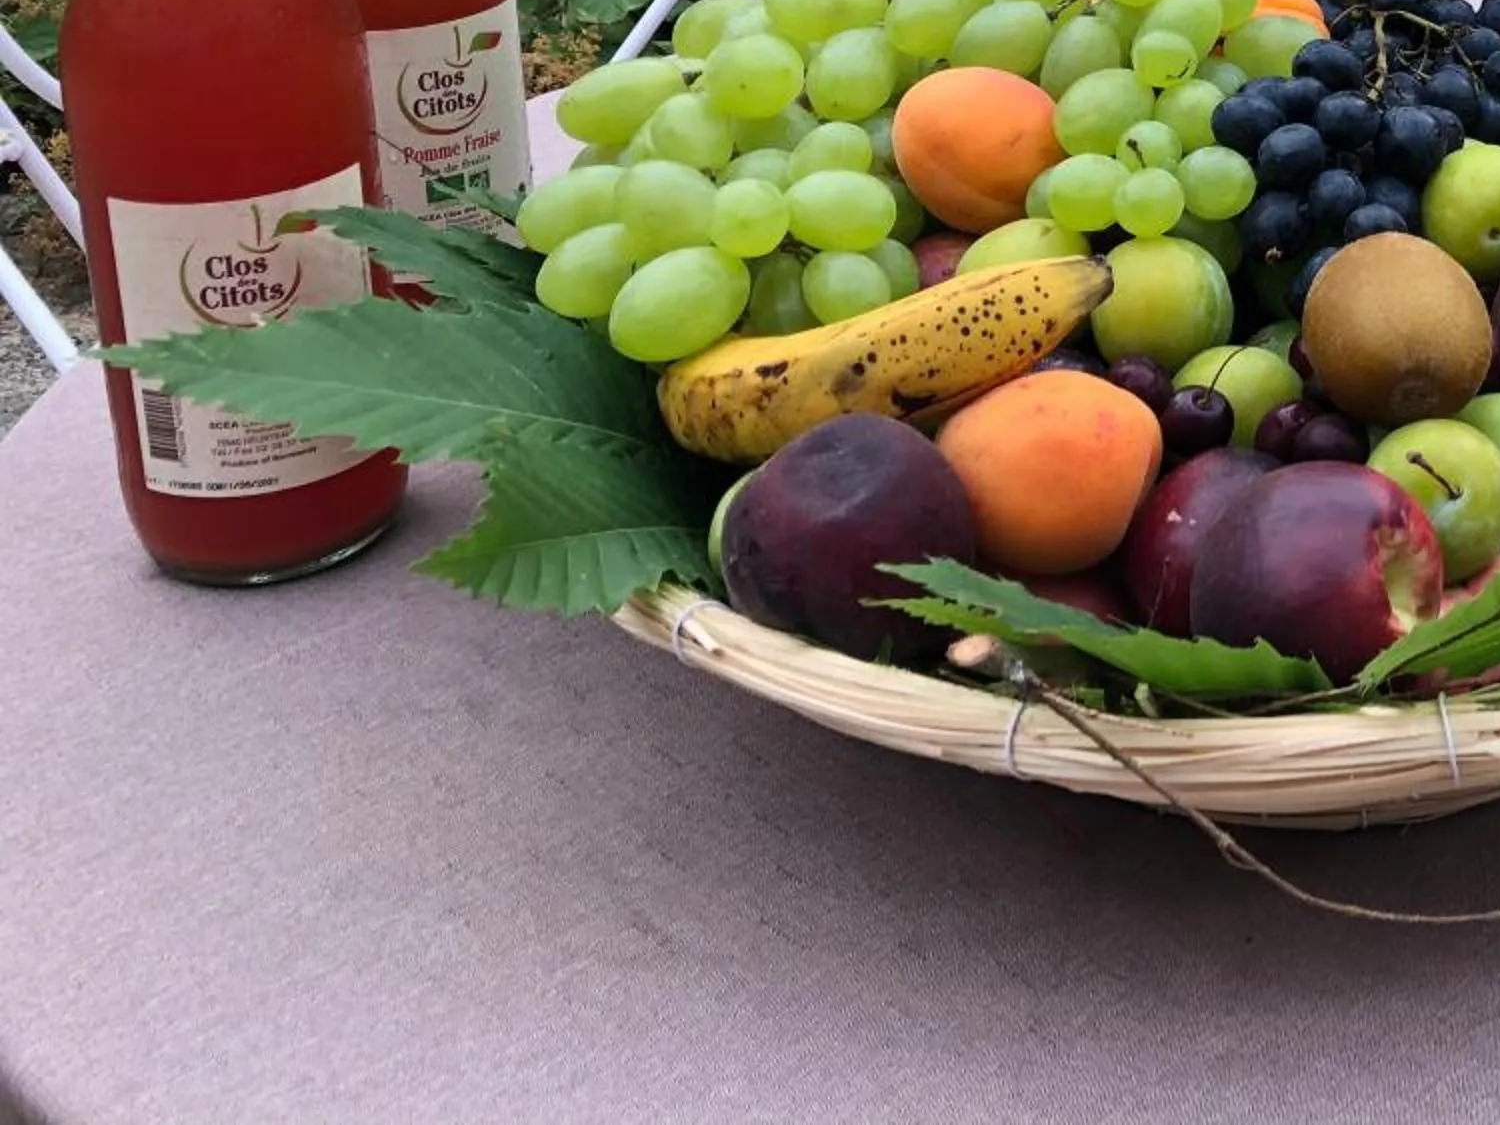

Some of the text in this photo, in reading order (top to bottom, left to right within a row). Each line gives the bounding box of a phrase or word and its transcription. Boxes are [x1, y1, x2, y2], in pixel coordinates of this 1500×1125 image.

[417, 70, 465, 92] Clos
[413, 92, 476, 118] Citots
[403, 128, 501, 164] Pomme Fraise
[205, 255, 269, 280] Clos
[237, 277, 257, 288] des
[200, 281, 285, 311] Citots
